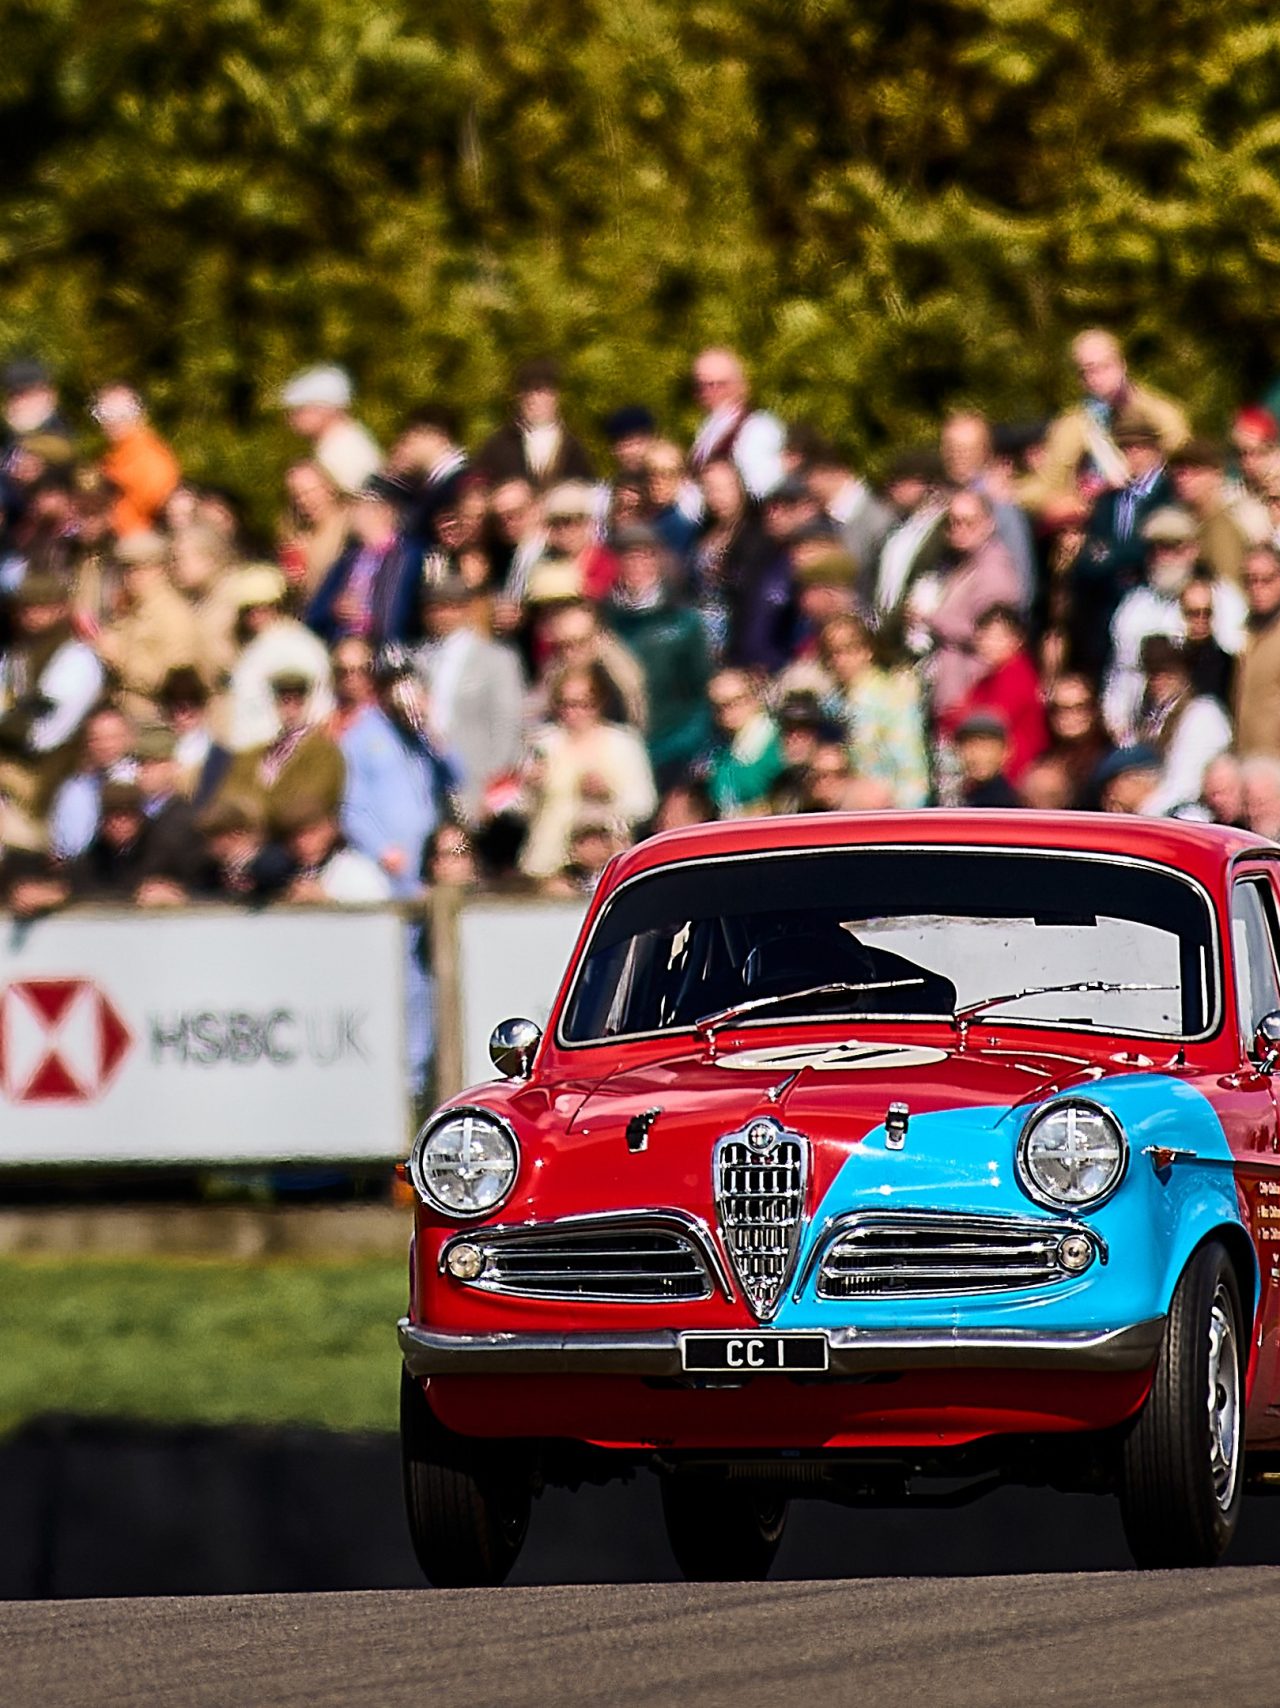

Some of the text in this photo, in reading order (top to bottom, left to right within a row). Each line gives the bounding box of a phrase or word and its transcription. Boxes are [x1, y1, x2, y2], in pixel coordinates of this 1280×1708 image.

[151, 1008, 374, 1067] HSBC UK
[726, 1340, 765, 1367] CC
